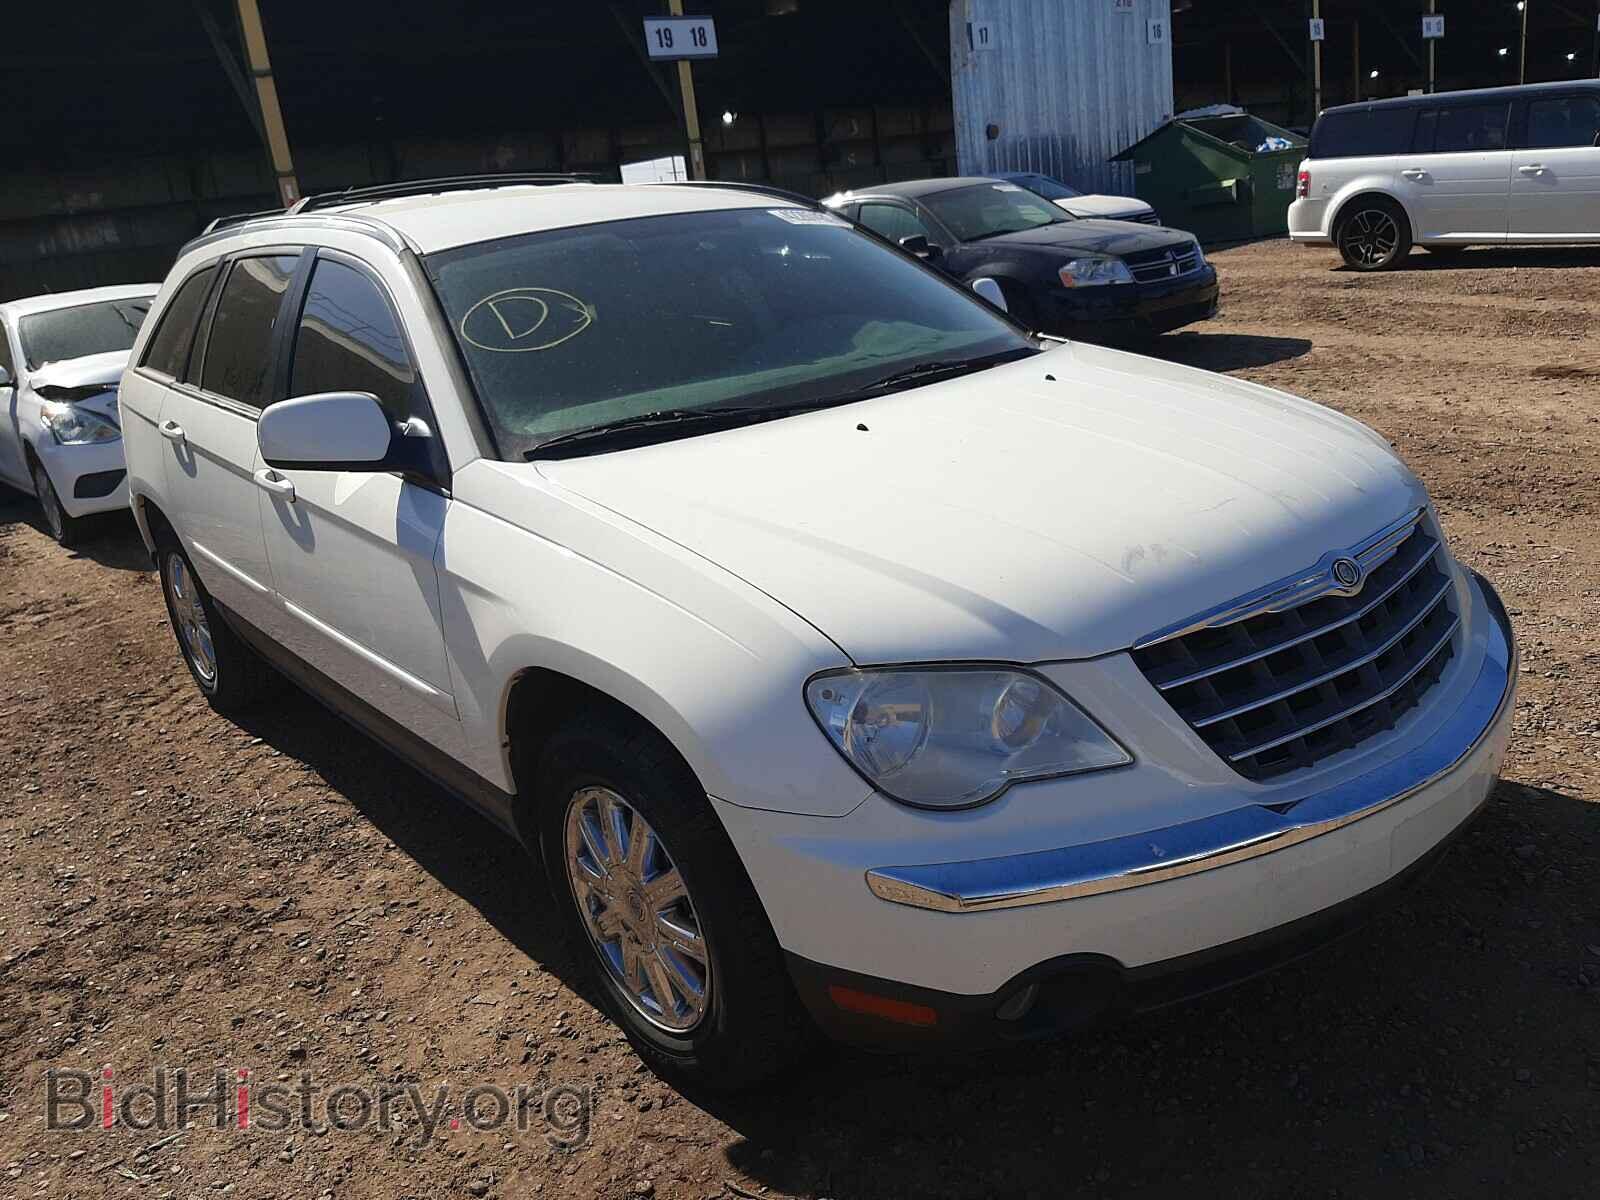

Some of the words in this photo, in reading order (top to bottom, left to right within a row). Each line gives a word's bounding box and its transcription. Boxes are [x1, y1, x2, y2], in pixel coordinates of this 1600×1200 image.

[656, 27, 673, 48] 19
[690, 26, 707, 46] 18
[487, 295, 549, 340] D
